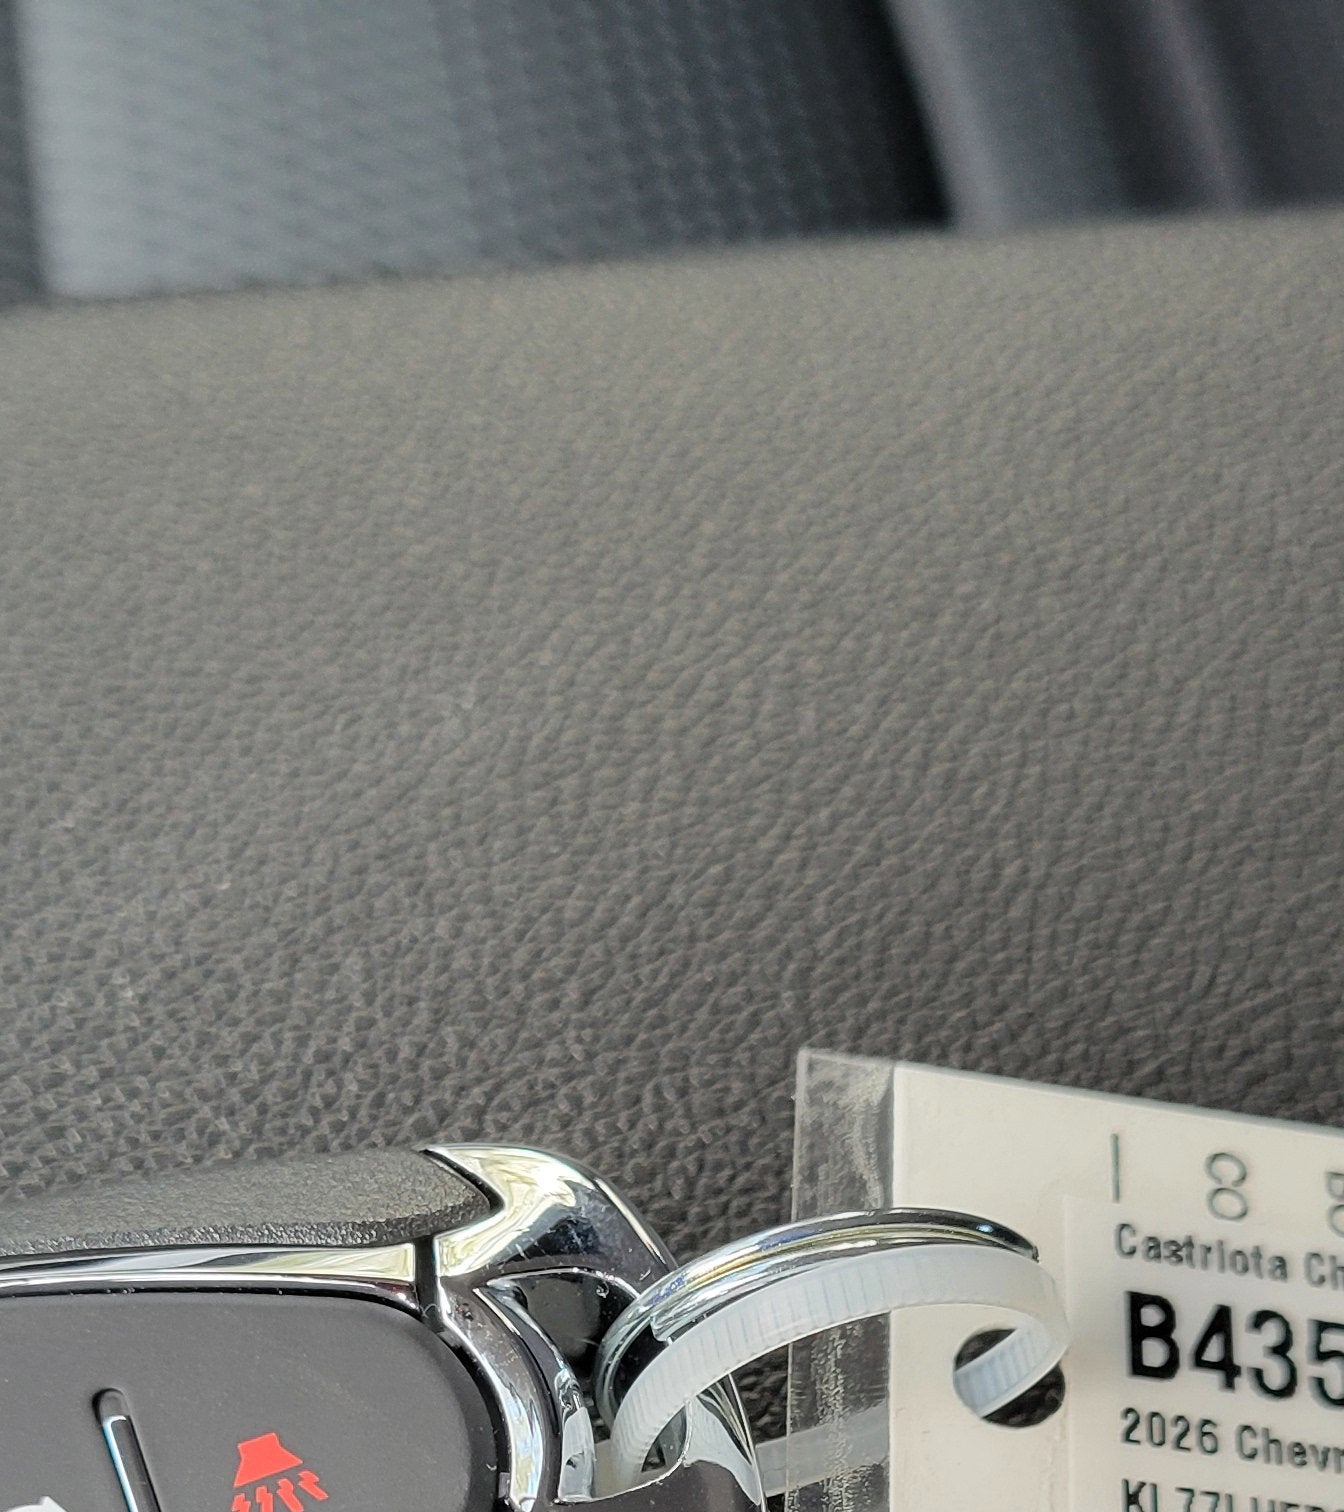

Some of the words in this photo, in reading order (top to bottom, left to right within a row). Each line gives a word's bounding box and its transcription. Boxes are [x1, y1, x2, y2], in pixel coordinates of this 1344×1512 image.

[1204, 1151, 1248, 1222] CO
[1115, 1222, 1289, 1281] Castriota
[1120, 1407, 1219, 1456] 2026
